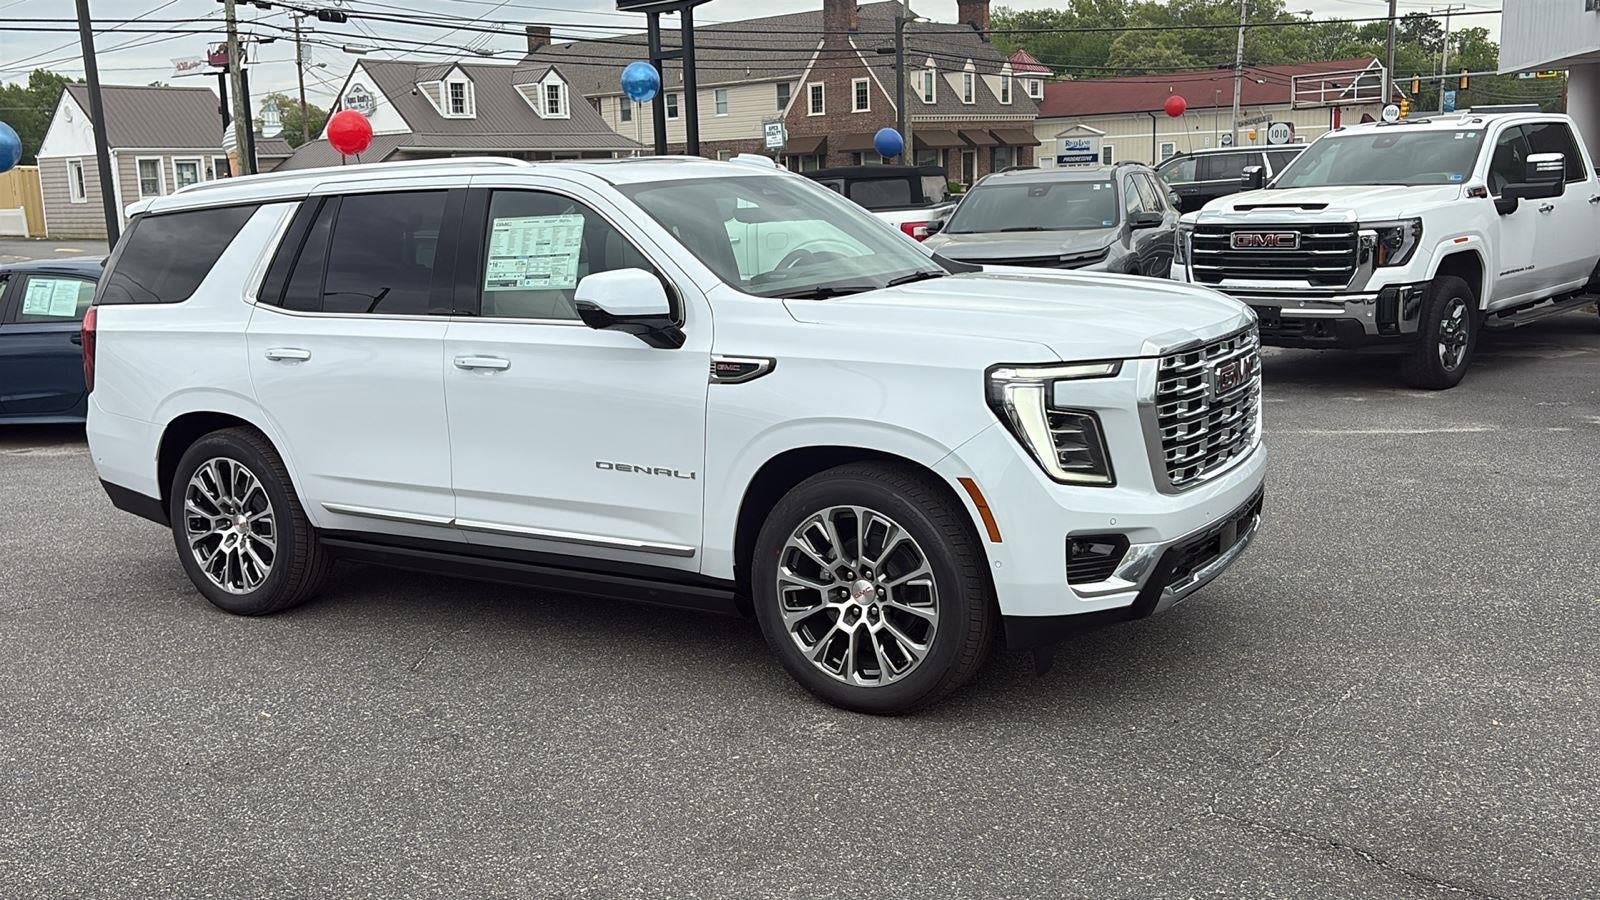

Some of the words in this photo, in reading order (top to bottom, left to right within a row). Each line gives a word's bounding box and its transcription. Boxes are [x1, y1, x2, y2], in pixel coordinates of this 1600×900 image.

[1272, 129, 1288, 138] 1010
[1235, 234, 1294, 246] GMC
[596, 461, 696, 480] DENALI
[854, 586, 872, 598] GMC
